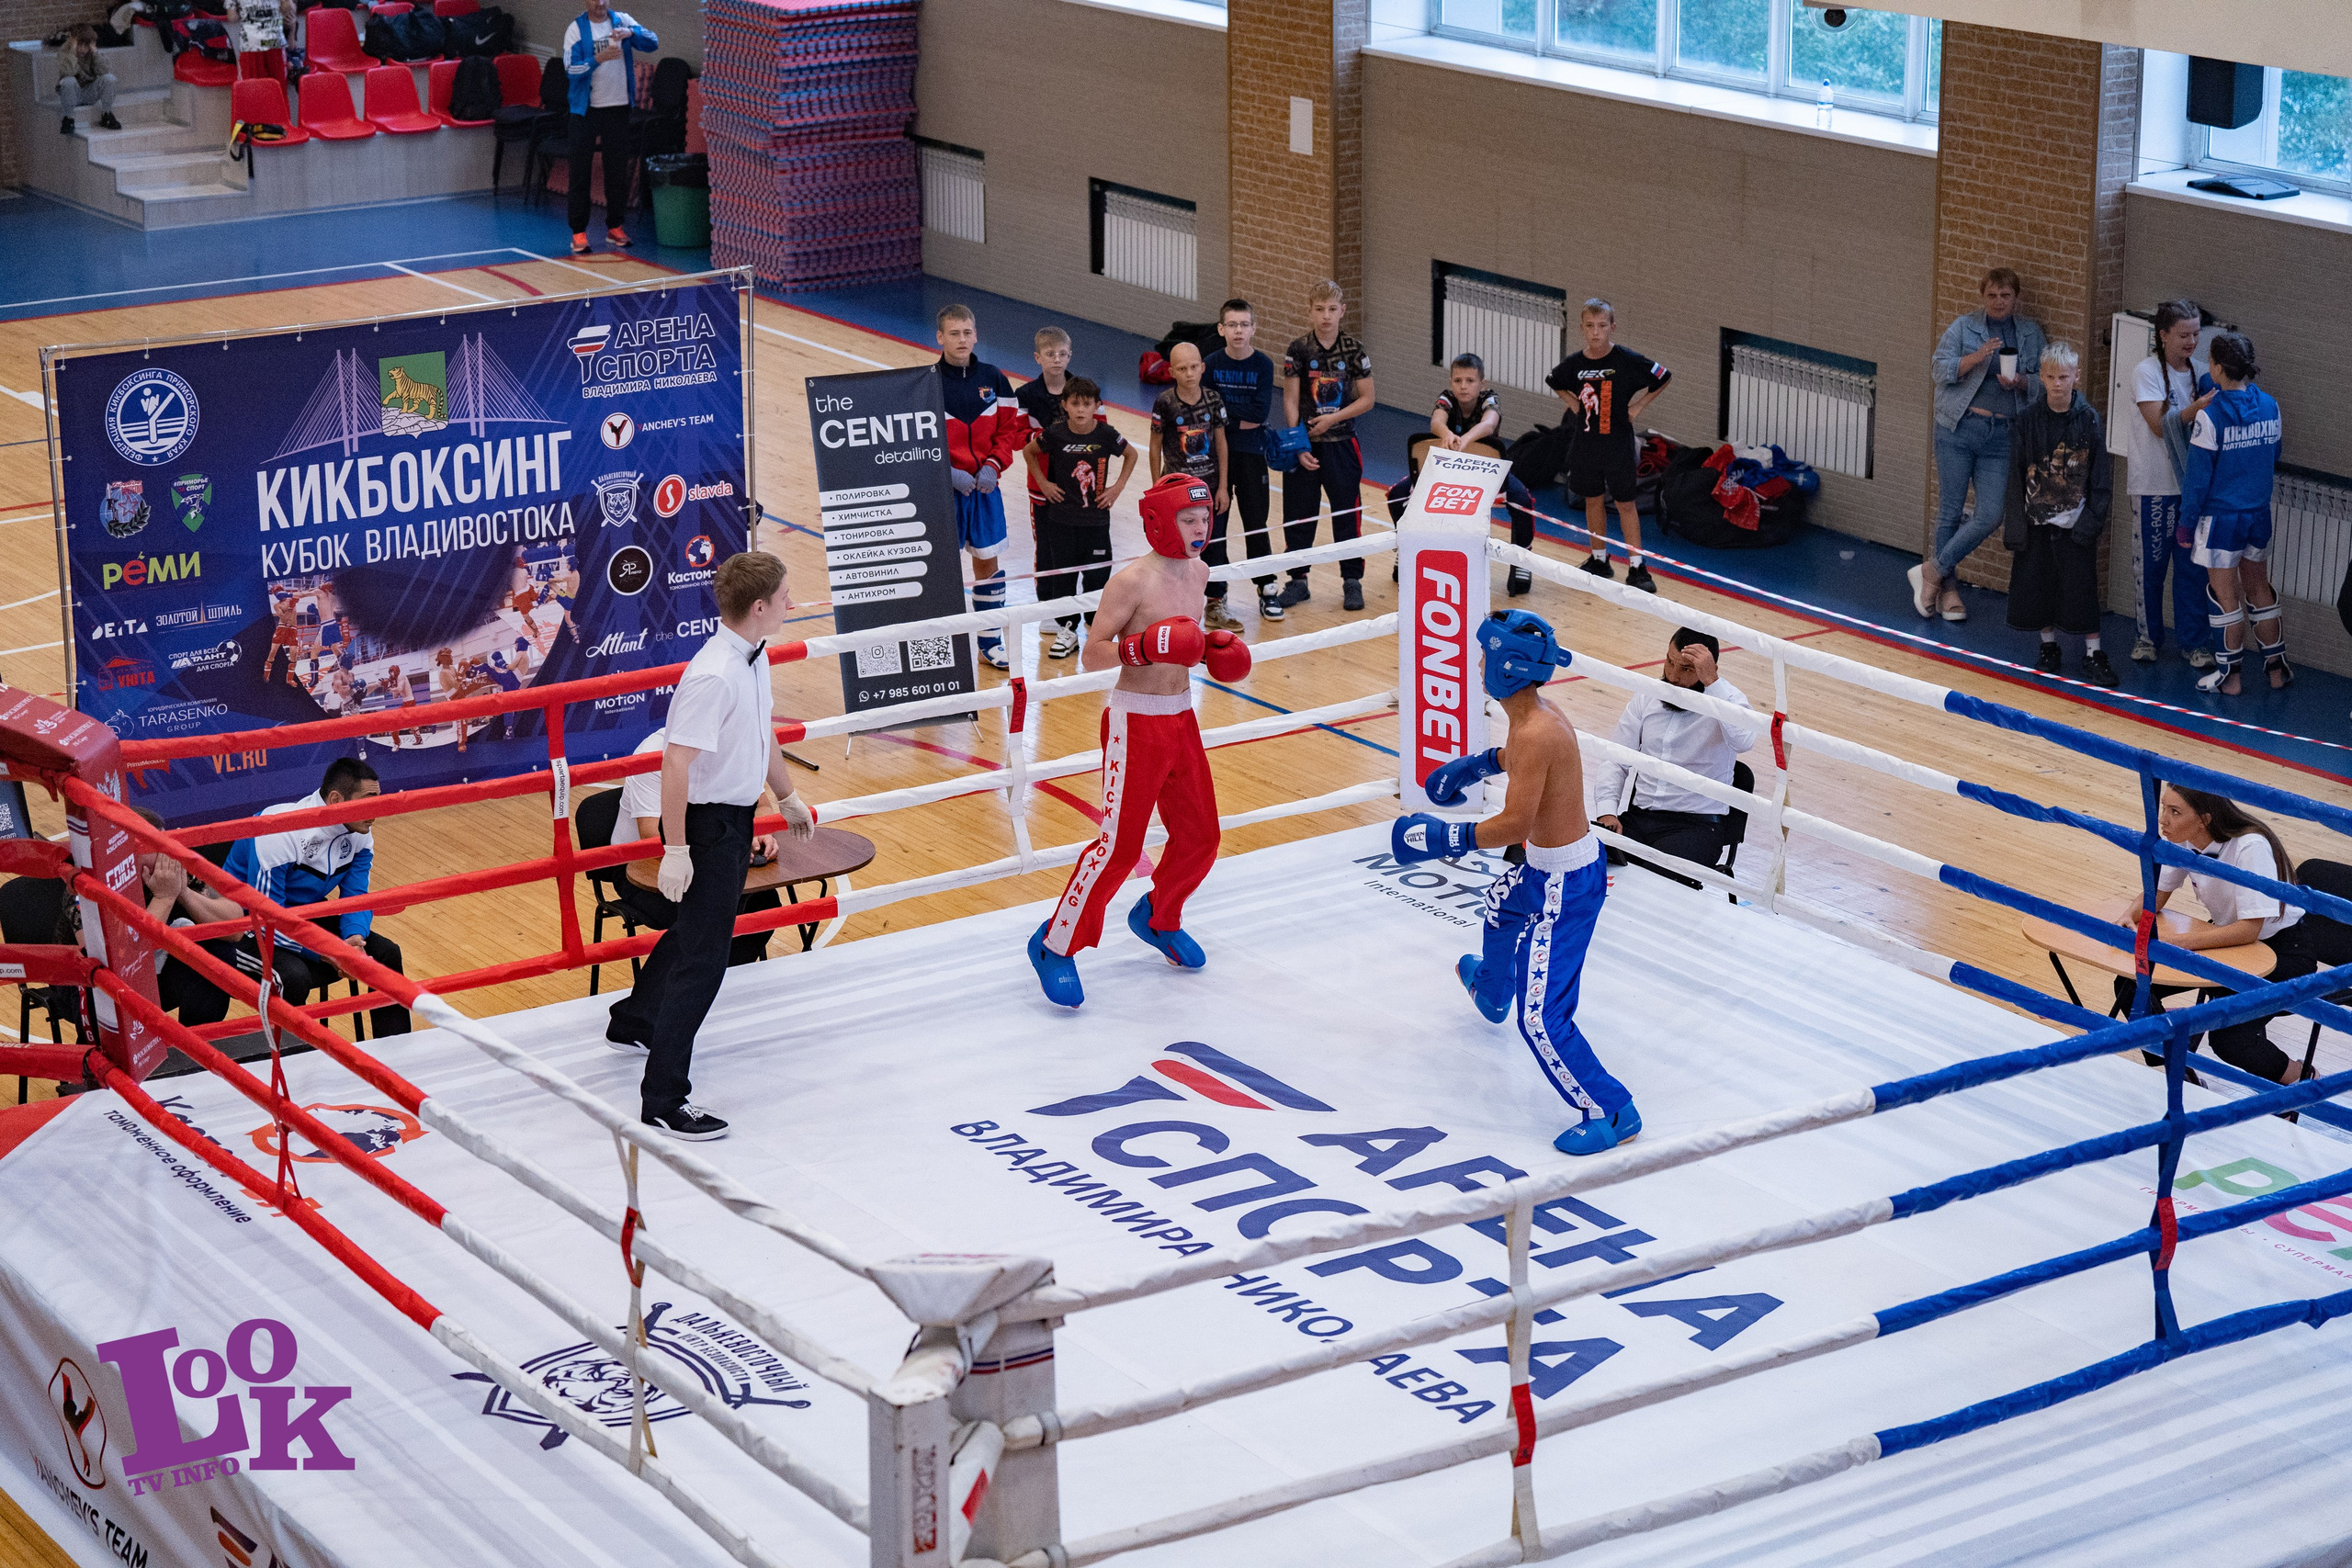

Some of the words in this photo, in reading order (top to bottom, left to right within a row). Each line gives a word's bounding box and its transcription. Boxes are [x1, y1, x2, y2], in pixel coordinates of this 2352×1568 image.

[614, 312, 716, 349] АРЕНА
[595, 344, 717, 383] СПОРТА
[109, 371, 163, 412] КИКБОКСИНГА
[582, 379, 651, 399] ВЛАДИМИРА
[653, 369, 717, 389] НИКОЛАЕВА
[166, 374, 197, 436] ПРИМОРСКОГО
[815, 394, 854, 413] the
[688, 413, 714, 425] TEAM
[819, 411, 938, 449] CENTR
[108, 417, 143, 461] ФЕДЕРАЦИЯ
[166, 438, 188, 458] КРАЯ
[2222, 438, 2262, 451] NATIONAL
[875, 446, 942, 466] detailing
[1442, 462, 1498, 475] СПОРТА
[1453, 457, 1500, 468] АРЕНА
[256, 430, 571, 531] КИКБОКСИНГ
[688, 481, 732, 502] slavda
[1432, 486, 1480, 499] FON
[835, 488, 891, 502] ПОЛИРОВКА
[1428, 496, 1476, 511] BET
[838, 507, 892, 522] ХИМЧИСТКА
[261, 533, 350, 579] КУБОК
[366, 502, 576, 563] ВЛАДИВОСТОКА
[840, 527, 895, 541] ТОНИРОВКА
[842, 548, 886, 561] ОКЛЕЙКА
[887, 544, 923, 556] КУЗОВА
[667, 565, 722, 585] Кастом-
[845, 567, 899, 581] АВТОВИНИЛ
[847, 587, 896, 601] АНТИХРОМ
[156, 609, 198, 626] ЗОЛОТОЙ
[208, 604, 243, 620] ШПИЛЬ
[656, 631, 674, 642] the
[676, 616, 723, 637] CENT
[168, 650, 189, 660] СПОРТ
[189, 649, 203, 657] ДЛЯ
[203, 647, 220, 655] ВСЕХ
[585, 628, 649, 659] Atlant
[210, 661, 235, 671] СПОРТА
[1422, 567, 1461, 762] FONBET
[873, 690, 888, 701] +7
[888, 687, 910, 699] 985
[911, 683, 931, 696] 601
[933, 682, 946, 694] 01
[947, 681, 960, 692] 01
[138, 703, 229, 728] TARASENKO
[147, 701, 187, 713] ЮРИДИЧЕСКАЯ
[187, 696, 218, 707] КОМПАНИЯ
[166, 721, 201, 733] GROUP
[556, 760, 566, 817] spartaequip.com
[1102, 760, 1120, 819] KICK
[1068, 831, 1110, 908] BOXING
[1363, 880, 1477, 929] International
[104, 1109, 176, 1165] таможенное
[171, 1163, 253, 1224] оформление
[949, 1120, 1215, 1258] ВЛАДИМИРА
[1296, 1125, 1785, 1352] АРЕНА
[669, 1312, 810, 1393] ДАЛЬНЕВОСТОЧНЫЙ
[678, 1333, 706, 1352] ЦЕНТР
[701, 1344, 752, 1382] БЕЗОПАСНОСТИ
[1213, 1272, 1497, 1425] НИКОАЕВА
[28, 1448, 100, 1537] YANCHEV'S
[104, 1517, 148, 1568] TEAM
